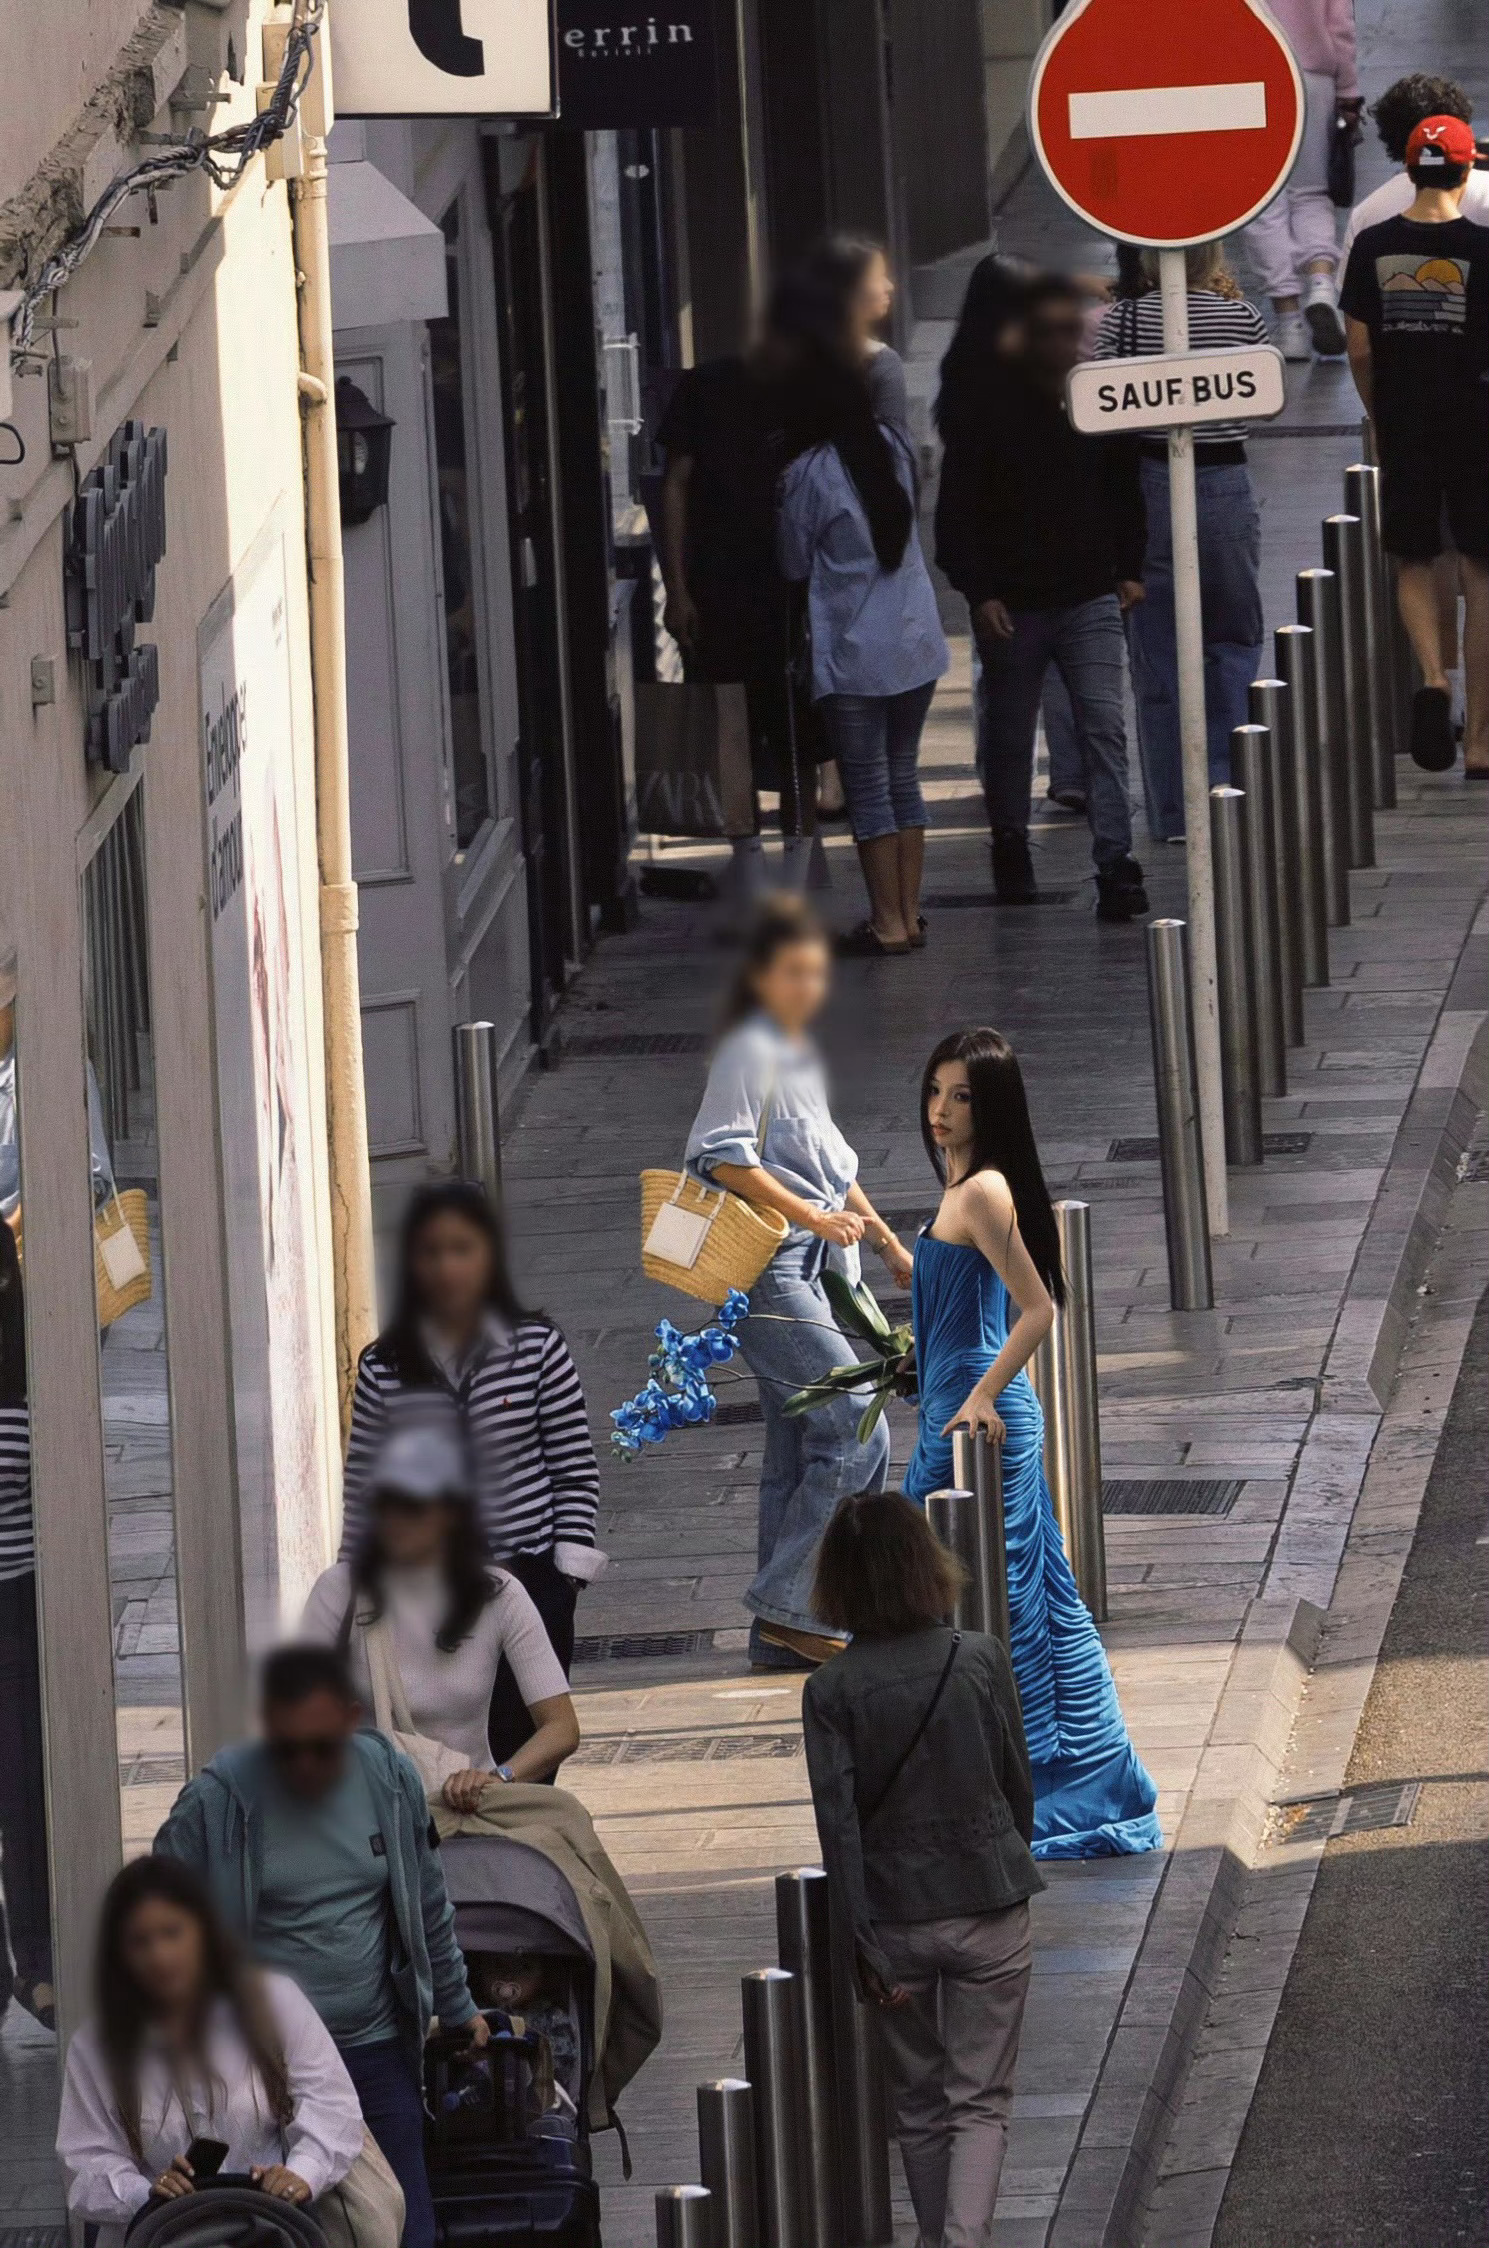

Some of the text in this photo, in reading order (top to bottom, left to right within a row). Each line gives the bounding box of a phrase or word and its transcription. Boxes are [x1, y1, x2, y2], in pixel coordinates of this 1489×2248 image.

[564, 17, 693, 48] errin
[1098, 370, 1257, 412] SAUF BUS
